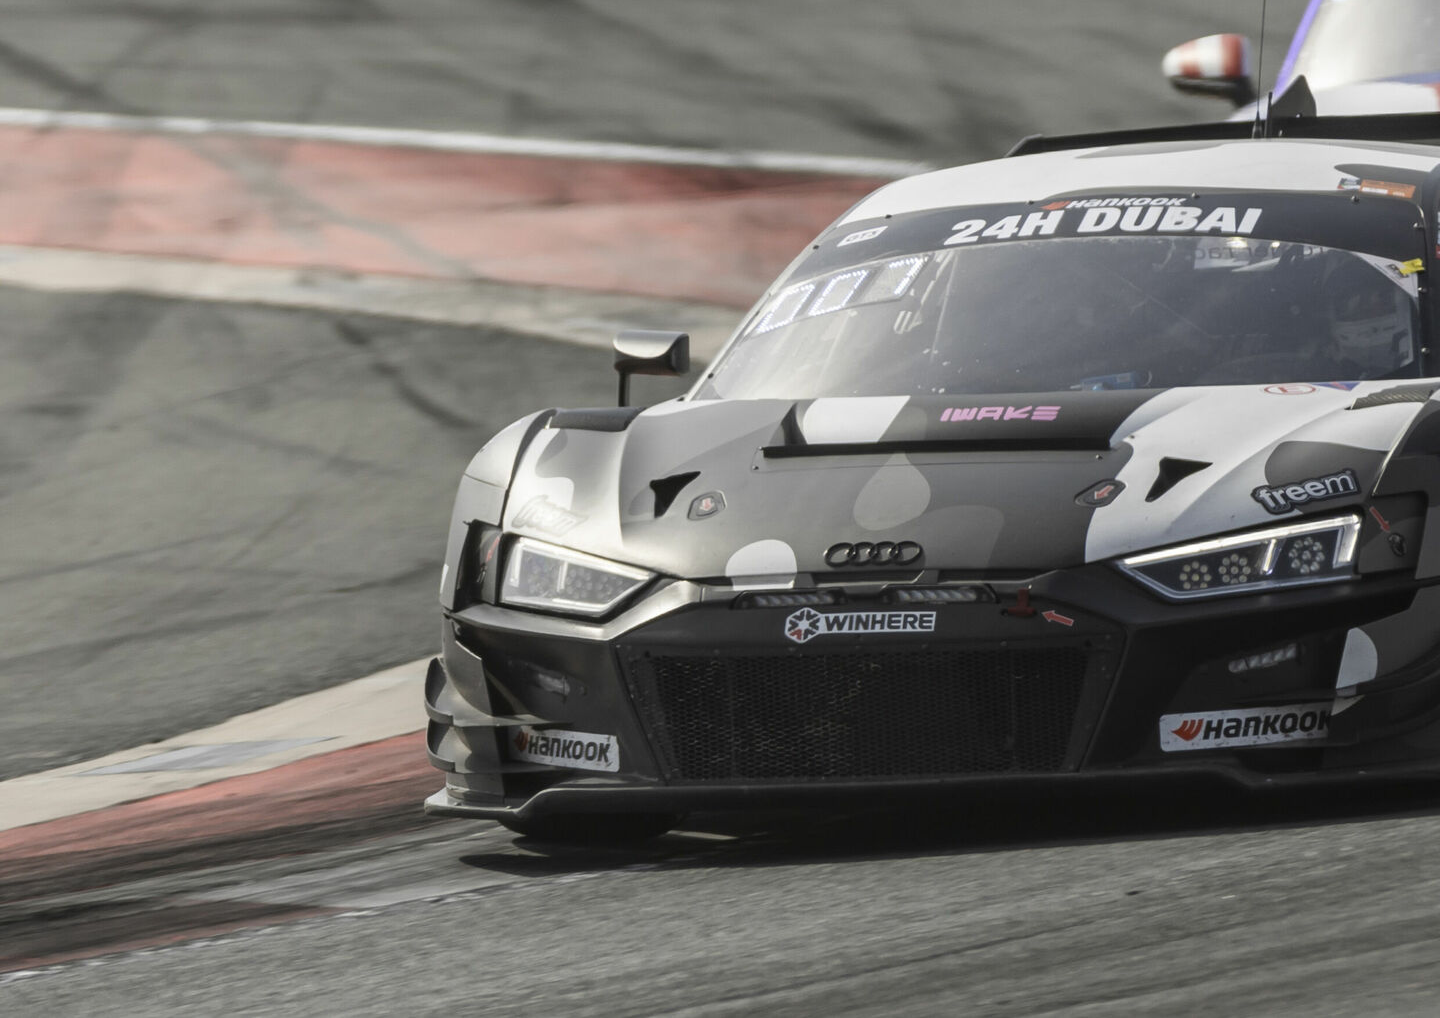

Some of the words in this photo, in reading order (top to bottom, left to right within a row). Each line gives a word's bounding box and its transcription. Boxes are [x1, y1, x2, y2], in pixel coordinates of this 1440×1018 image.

[943, 210, 1065, 245] 24H
[1076, 206, 1264, 234] DUBAI
[940, 405, 1062, 422] IWAKE
[1259, 474, 1355, 508] freem
[824, 613, 934, 632] WINHERE
